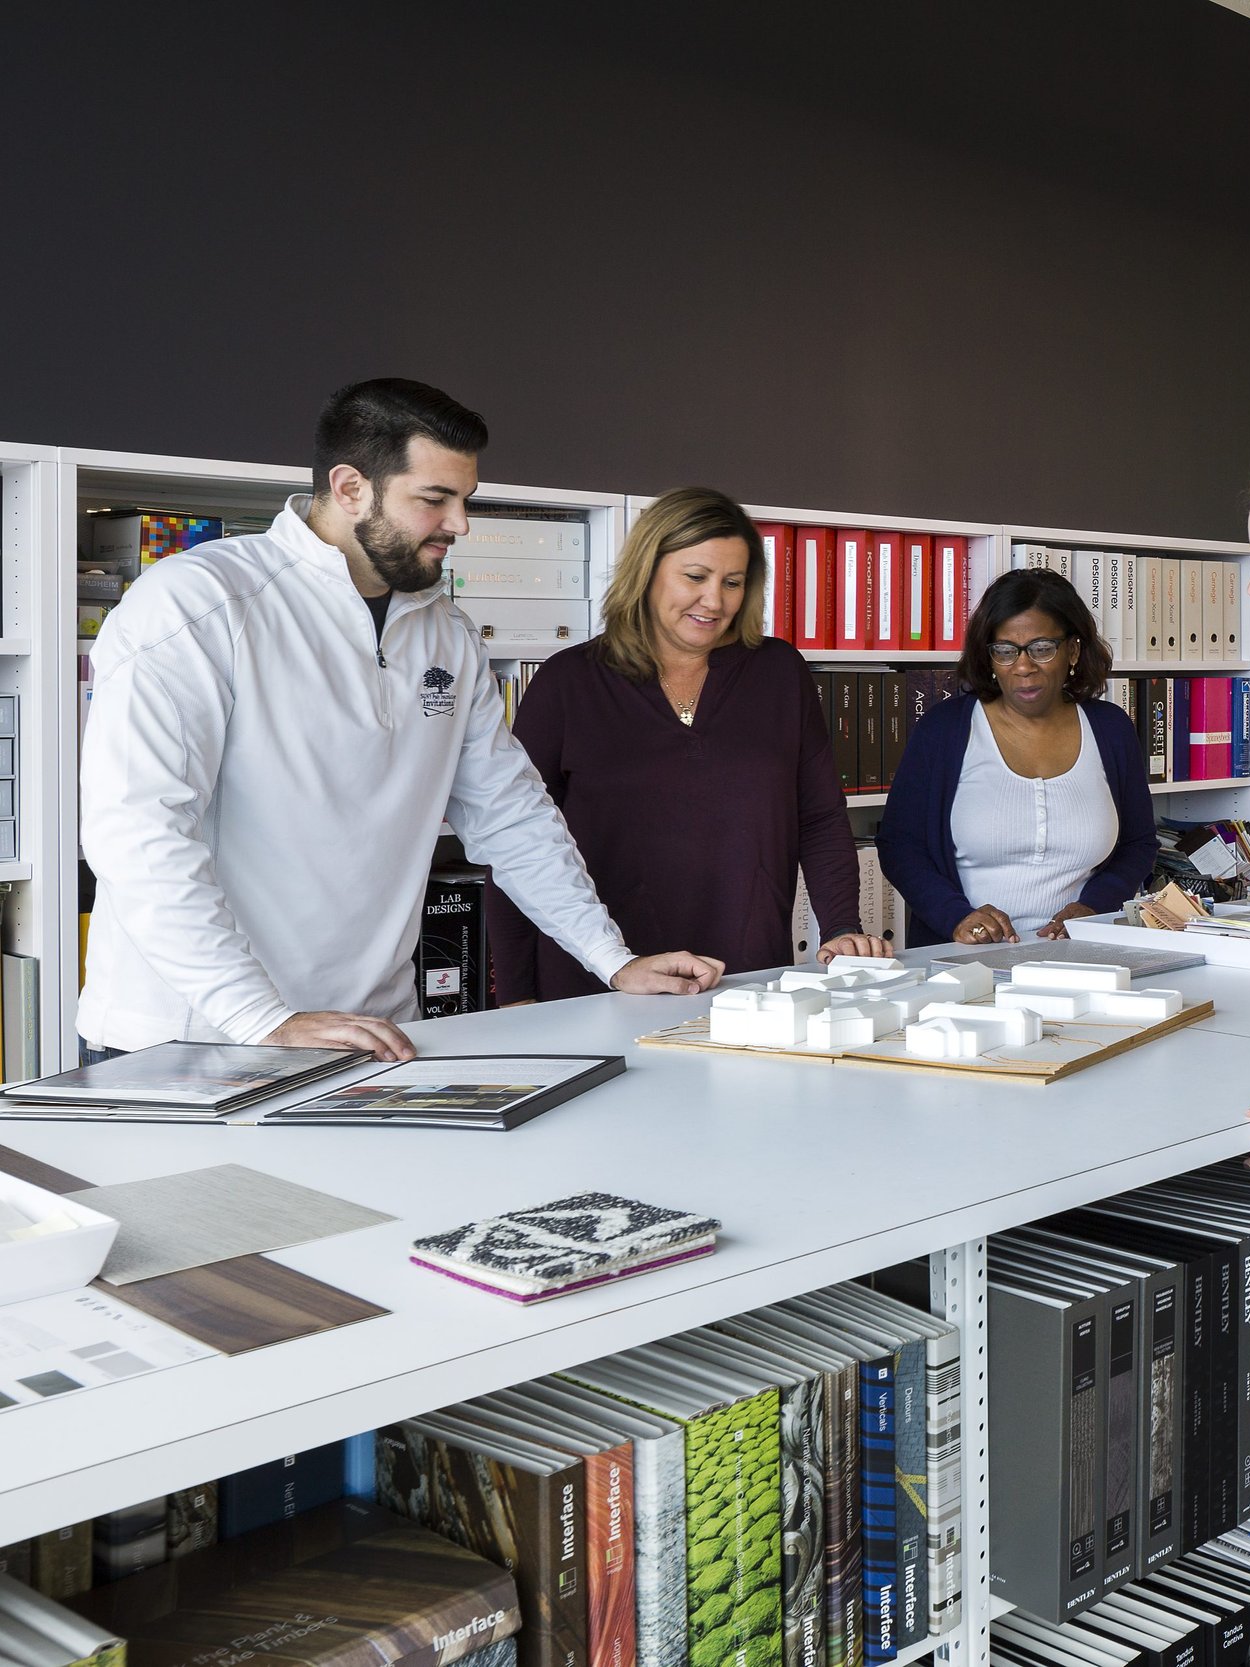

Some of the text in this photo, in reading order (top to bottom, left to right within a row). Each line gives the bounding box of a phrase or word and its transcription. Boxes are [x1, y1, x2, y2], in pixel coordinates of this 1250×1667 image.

[422, 699, 455, 707] Invitational
[427, 902, 472, 915] DESIGNS
[440, 893, 462, 904] LAB
[460, 925, 469, 1014] ARCHITECTURAL LAMINAT
[427, 1005, 442, 1014] VOL
[1194, 1275, 1203, 1348] BENTLEY
[1221, 1263, 1230, 1334] BENTLEY
[878, 1391, 887, 1432] Verticals
[803, 1427, 811, 1525] Narratives Collection
[561, 1483, 574, 1562] Interface
[735, 1455, 745, 1601] Human Connections Collection
[1148, 1543, 1174, 1565] BENTLEY
[944, 1551, 955, 1615] Interface
[1104, 1564, 1131, 1585] BENTLEY
[880, 1584, 891, 1651] Interface
[1066, 1587, 1096, 1610] BENTLEY
[230, 1612, 313, 1649] Plank &
[260, 1614, 339, 1652] Timbers
[432, 1609, 505, 1653] Interface
[803, 1616, 816, 1667] Interfa
[845, 1600, 856, 1667] Interface
[1222, 1631, 1244, 1650] Centiva
[1223, 1622, 1244, 1640] Tandus
[1175, 1646, 1194, 1664] Tandus
